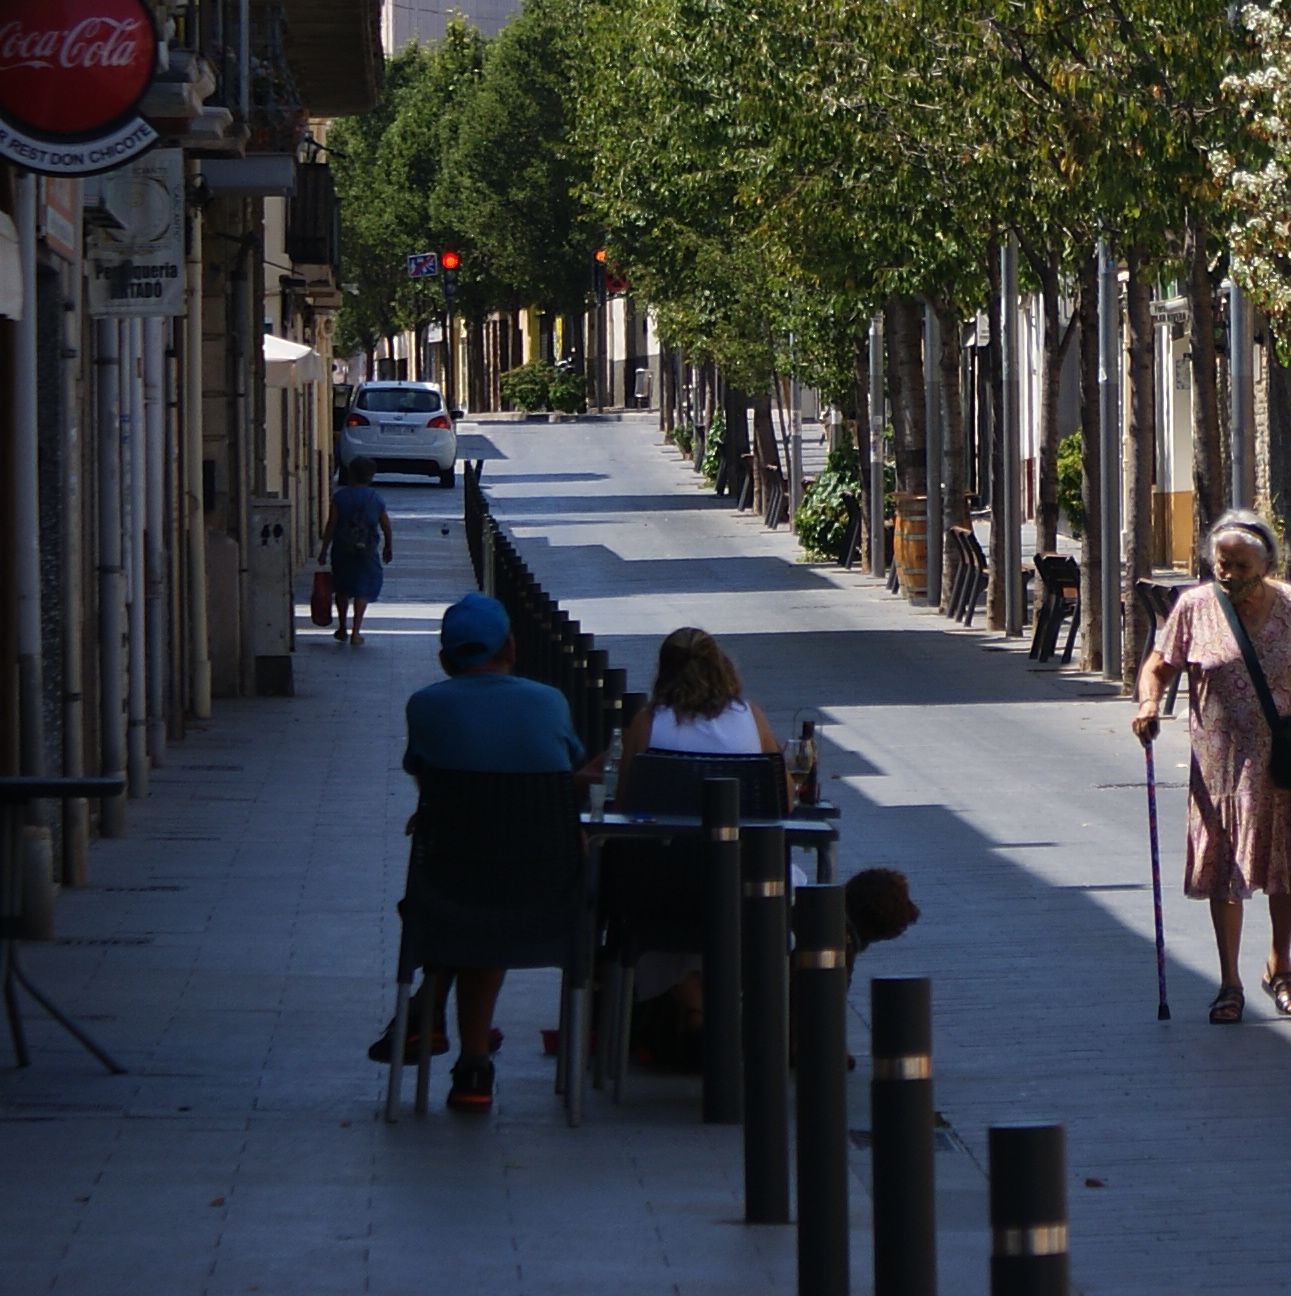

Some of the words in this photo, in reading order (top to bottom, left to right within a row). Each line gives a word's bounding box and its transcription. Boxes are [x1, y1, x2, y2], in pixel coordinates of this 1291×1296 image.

[8, 139, 48, 162] REST
[50, 153, 84, 167] DON
[90, 123, 152, 164] CHICOTE
[95, 262, 178, 280] Pequeria
